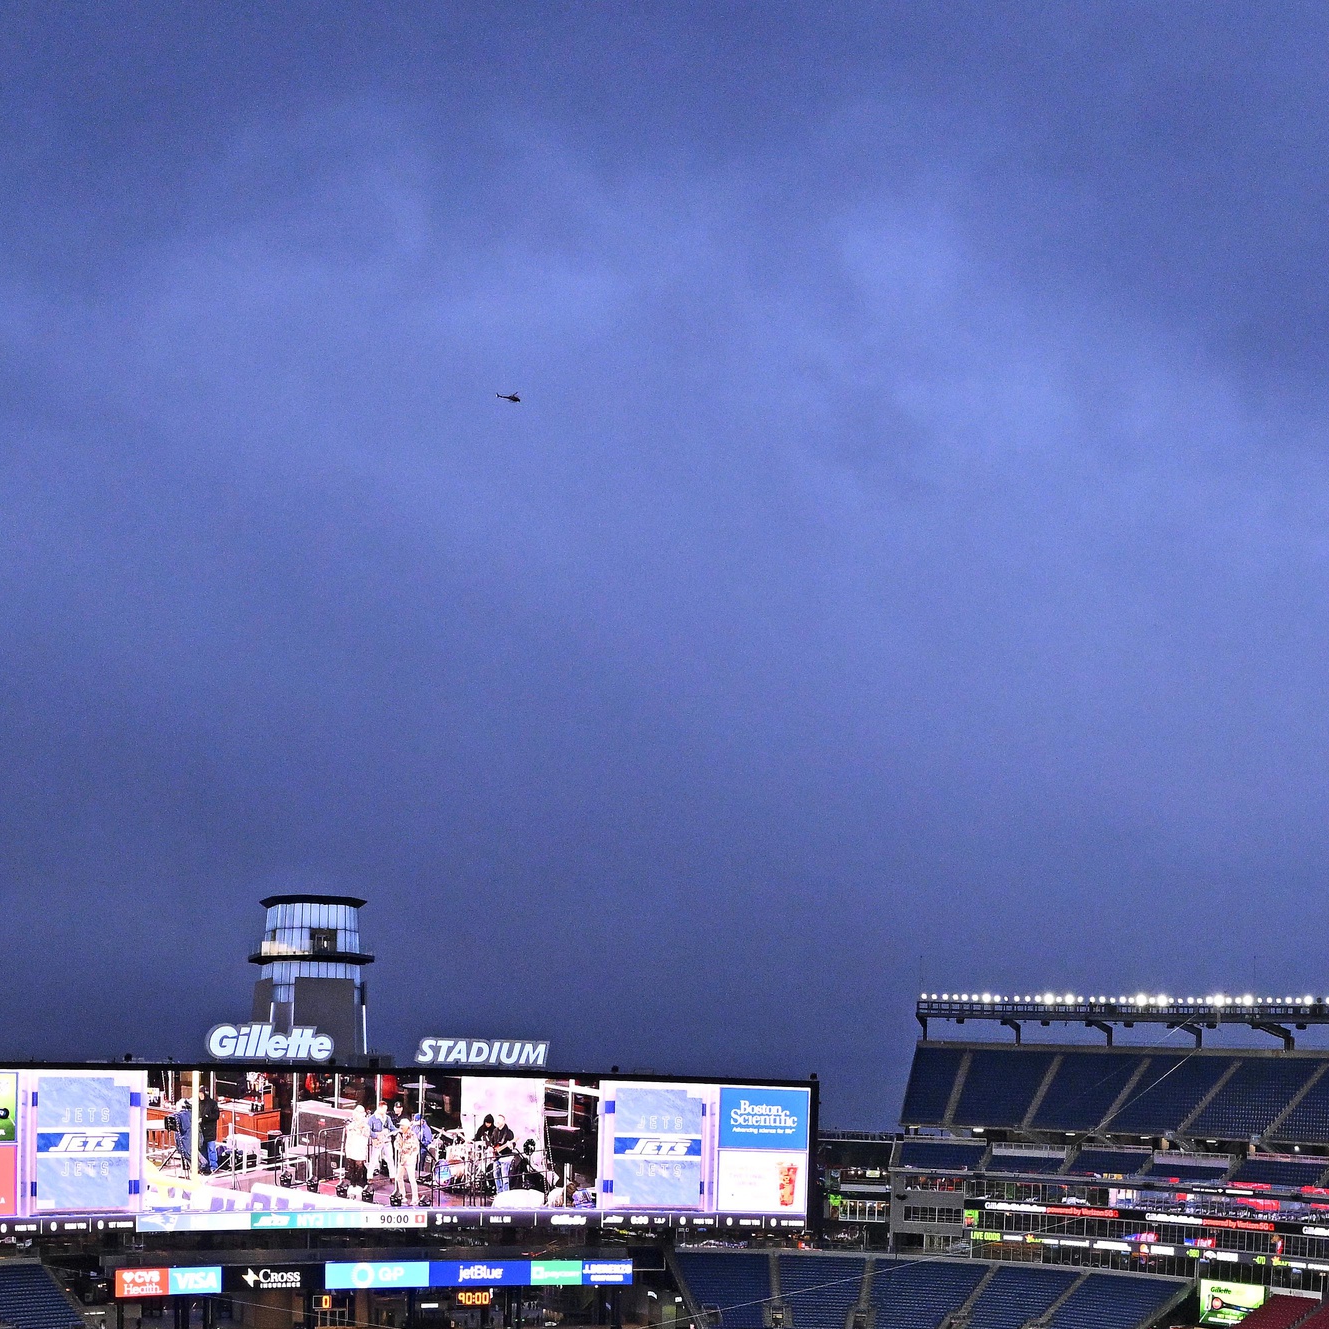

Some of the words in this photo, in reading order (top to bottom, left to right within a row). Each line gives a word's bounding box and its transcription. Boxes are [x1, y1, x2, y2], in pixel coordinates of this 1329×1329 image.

[209, 1024, 333, 1059] Gillette
[416, 1039, 548, 1066] STADIUM
[739, 1100, 783, 1114] Boston
[61, 1107, 111, 1123] JETS
[637, 1115, 683, 1130] JETS
[730, 1110, 798, 1127] Scientific
[48, 1132, 120, 1152] JETS
[624, 1137, 693, 1156] JETS
[60, 1160, 110, 1177] JETS
[635, 1163, 682, 1178] JETS
[379, 1214, 410, 1224] 90:00
[1075, 1208, 1083, 1218] by
[1083, 1208, 1105, 1217] Verizon
[1202, 1217, 1229, 1228] powered
[1229, 1220, 1236, 1230] by
[1236, 1220, 1256, 1230] Verizon
[970, 1231, 983, 1241] LIVE
[984, 1232, 1001, 1242] ODDS
[134, 1271, 160, 1283] CVS
[173, 1272, 219, 1290] VISA
[259, 1269, 301, 1283] CROSS
[378, 1266, 404, 1282] GP
[458, 1265, 504, 1283] jetBlue
[322, 1295, 330, 1308] 0
[457, 1292, 490, 1305] 90:00
